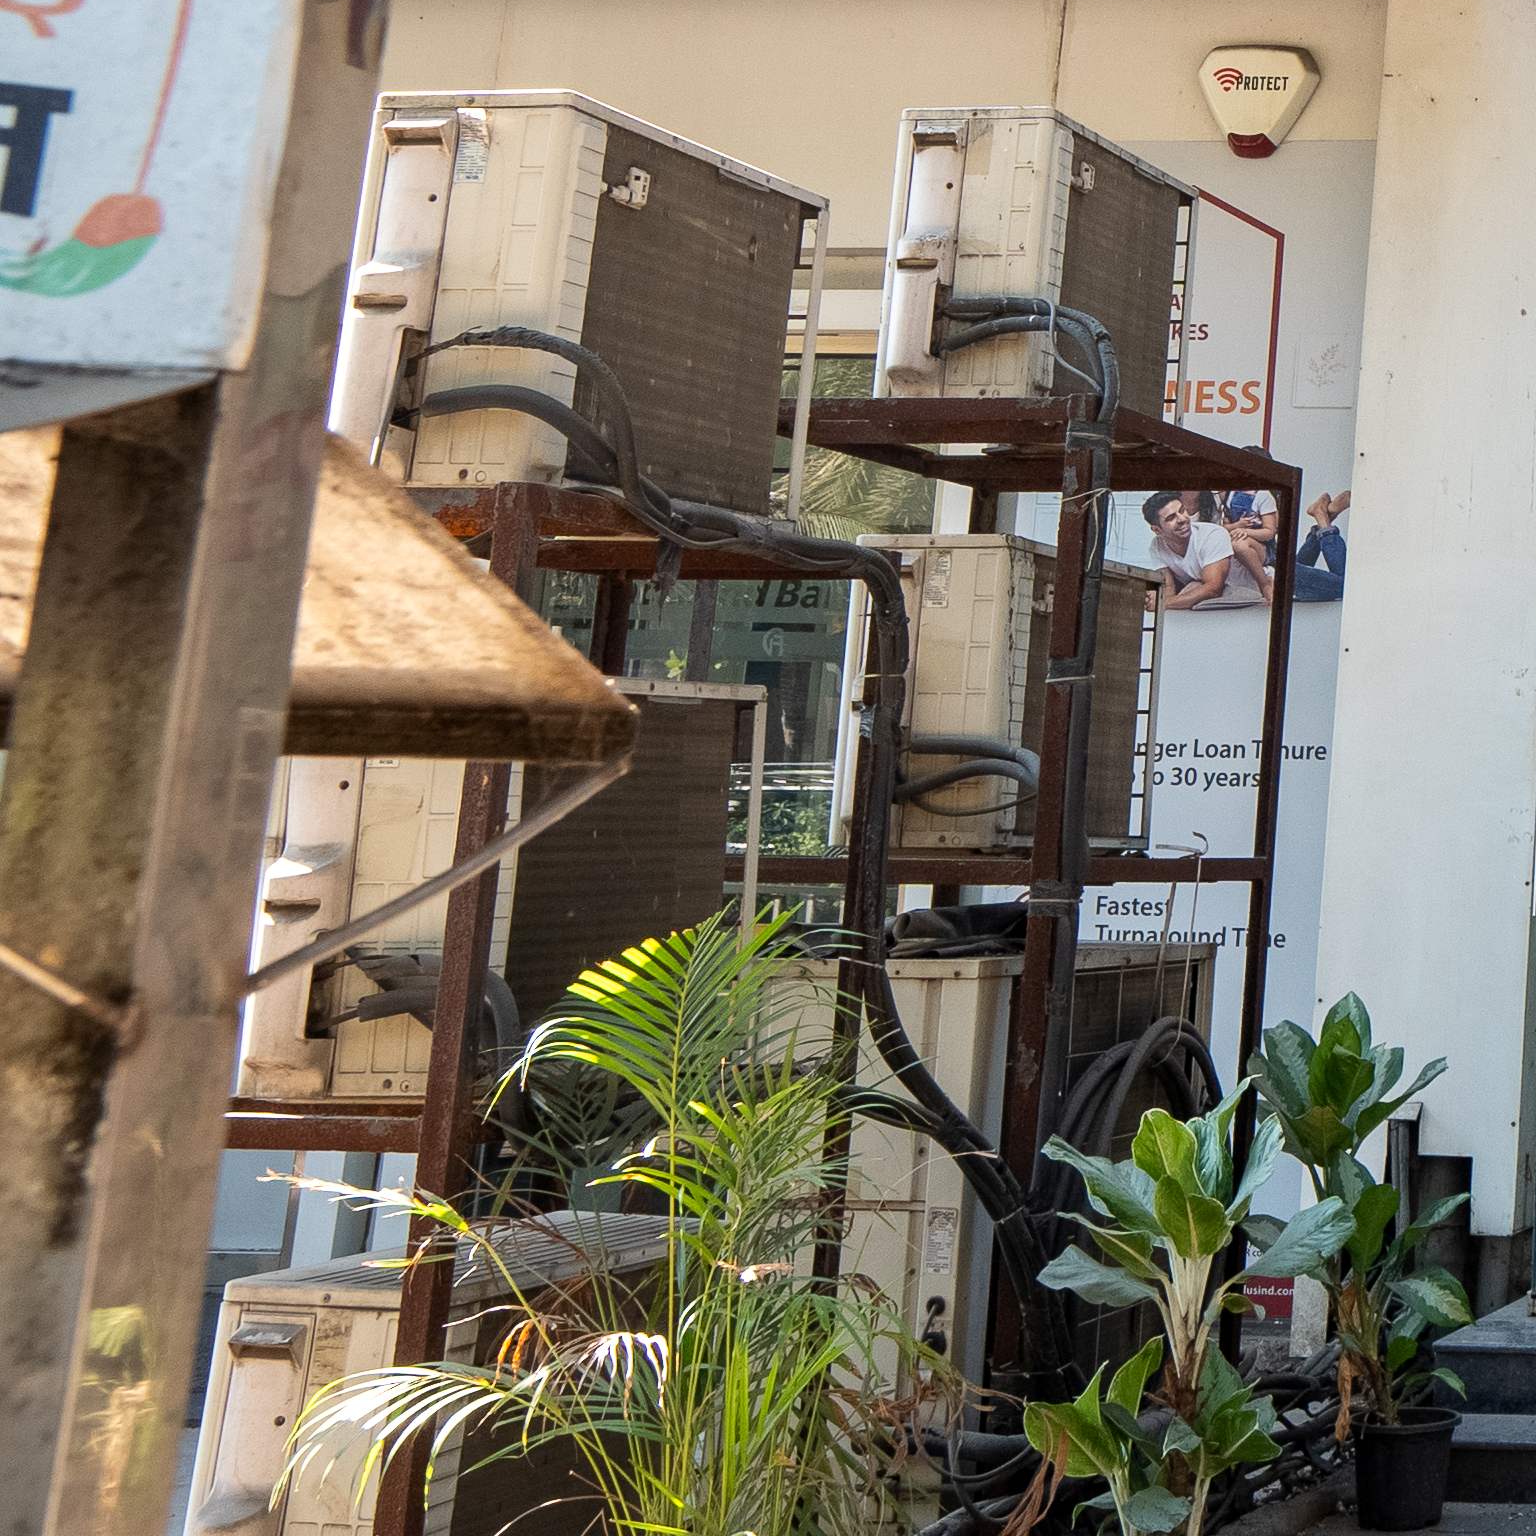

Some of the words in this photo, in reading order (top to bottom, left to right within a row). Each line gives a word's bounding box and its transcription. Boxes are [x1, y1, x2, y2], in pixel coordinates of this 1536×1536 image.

[1235, 76, 1289, 91] PROTECT
[1193, 739, 1246, 759] Loan
[1170, 767, 1197, 785] 30
[1203, 771, 1261, 791] years
